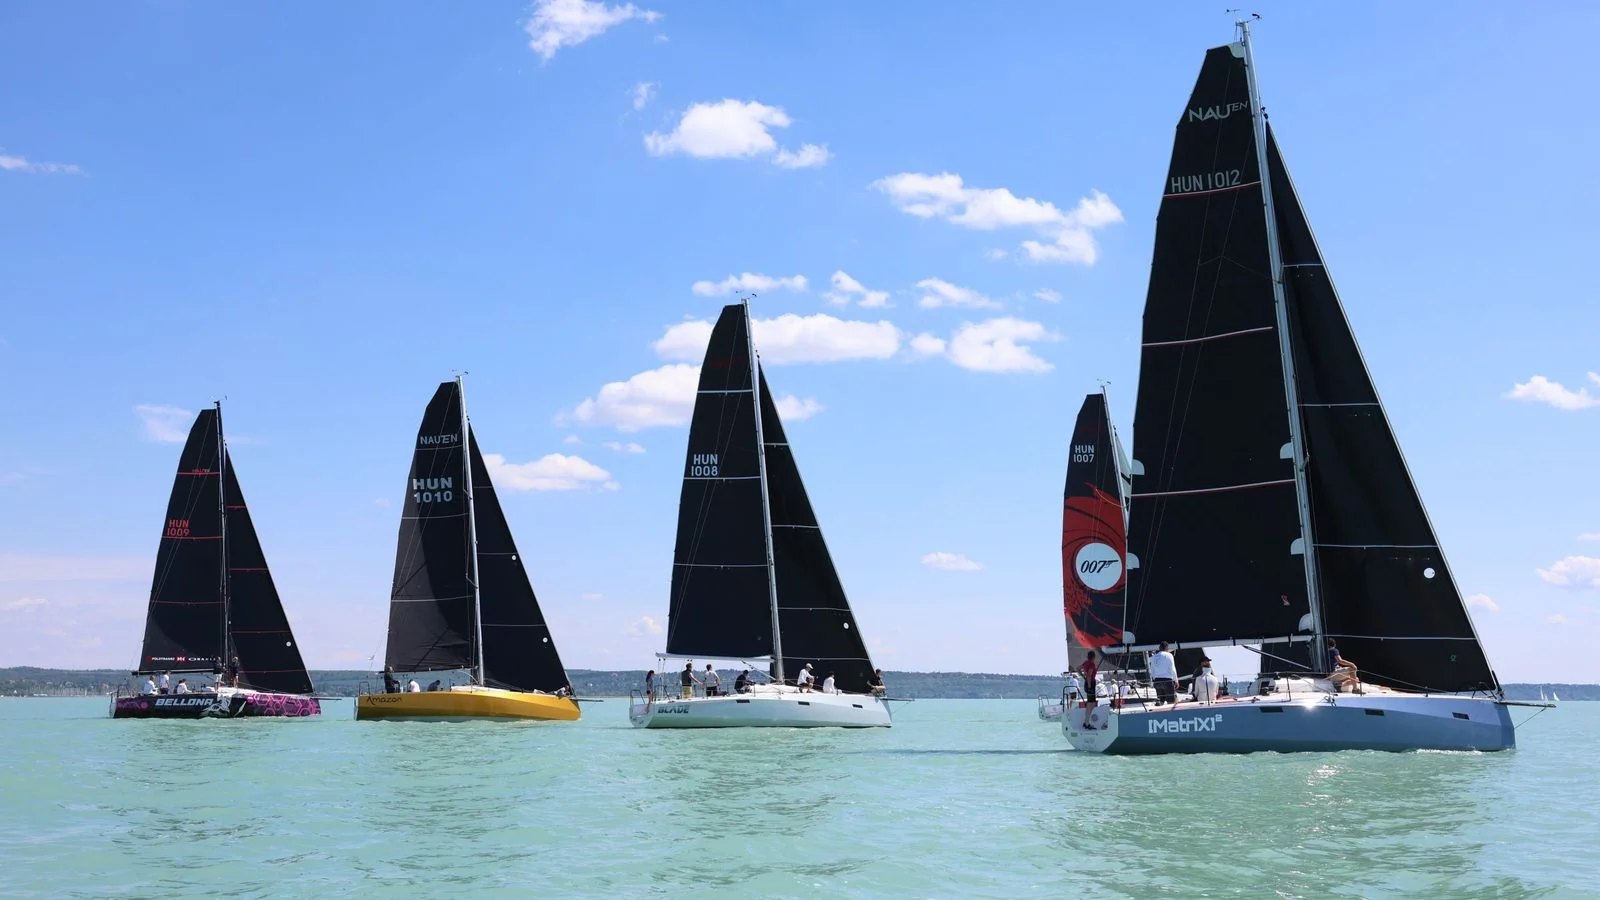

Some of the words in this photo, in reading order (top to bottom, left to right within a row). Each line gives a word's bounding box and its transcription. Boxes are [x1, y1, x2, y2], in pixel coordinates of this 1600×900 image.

[1171, 174, 1203, 193] HUN
[1208, 169, 1241, 190] 1012
[1074, 445, 1095, 454] HUN
[693, 454, 718, 465] HUN
[1073, 454, 1095, 463] 1007
[691, 466, 718, 477] 1008
[413, 477, 453, 490] HUN
[413, 490, 453, 504] 1010
[169, 519, 189, 528] HUN
[167, 528, 190, 537] 1009
[1080, 559, 1105, 574] 007
[155, 697, 213, 706] BELLONA
[366, 696, 403, 705] Amazon
[658, 705, 690, 714] BLADE
